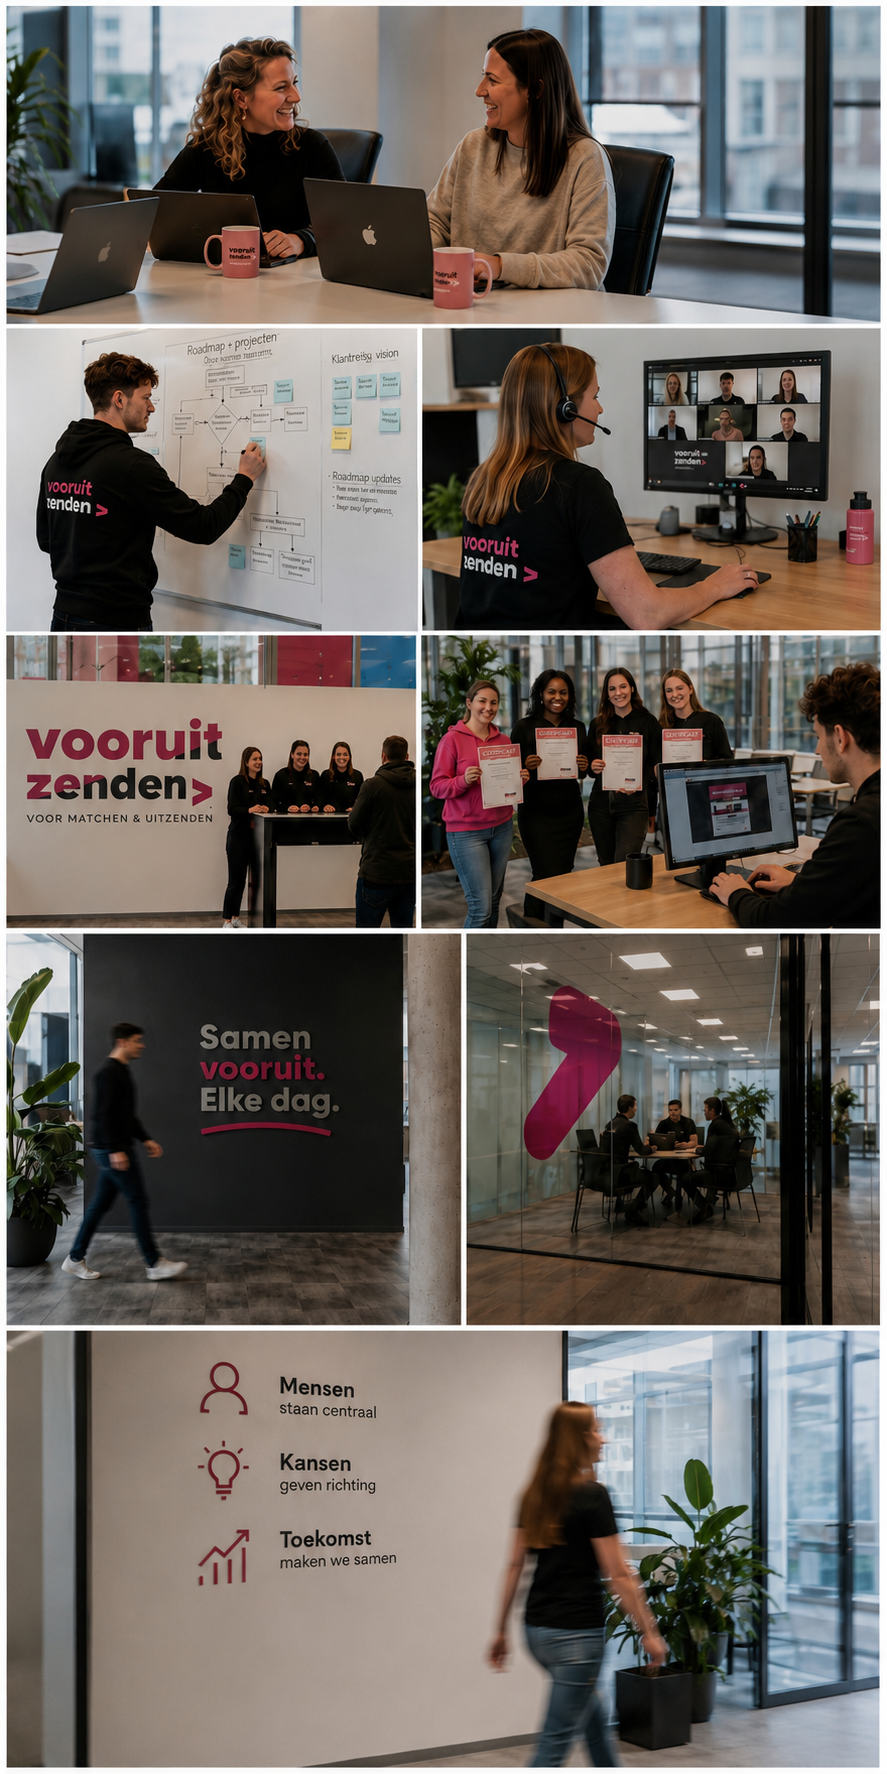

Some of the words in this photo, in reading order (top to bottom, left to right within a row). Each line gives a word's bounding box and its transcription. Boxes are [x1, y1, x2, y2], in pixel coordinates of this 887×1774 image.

[187, 343, 226, 356] Roadmap
[235, 333, 277, 352] projecten
[376, 349, 399, 359] vision
[47, 479, 93, 496] vooruit
[332, 471, 370, 485] Roadmap
[372, 474, 401, 486] updates
[463, 536, 519, 558] vooruit
[25, 718, 223, 761] vooruit
[26, 767, 187, 800] zenden
[26, 814, 63, 823] VOOR
[67, 814, 128, 823] MATCHEN
[133, 814, 141, 823] &
[145, 814, 213, 823] UITZENDEN
[200, 1023, 311, 1050] Samen
[199, 1053, 325, 1080] vooruit.
[201, 1086, 262, 1112] Elke
[270, 1086, 340, 1119] dag.
[280, 1376, 355, 1398] Mensen
[279, 1402, 318, 1416] staan
[322, 1405, 377, 1418] centraal
[280, 1453, 352, 1471] Kansen
[279, 1479, 322, 1494] geven
[326, 1478, 376, 1494] richting
[279, 1529, 371, 1548] Toekomst
[279, 1555, 326, 1569] maken
[330, 1556, 350, 1566] we
[354, 1554, 397, 1566] samen
